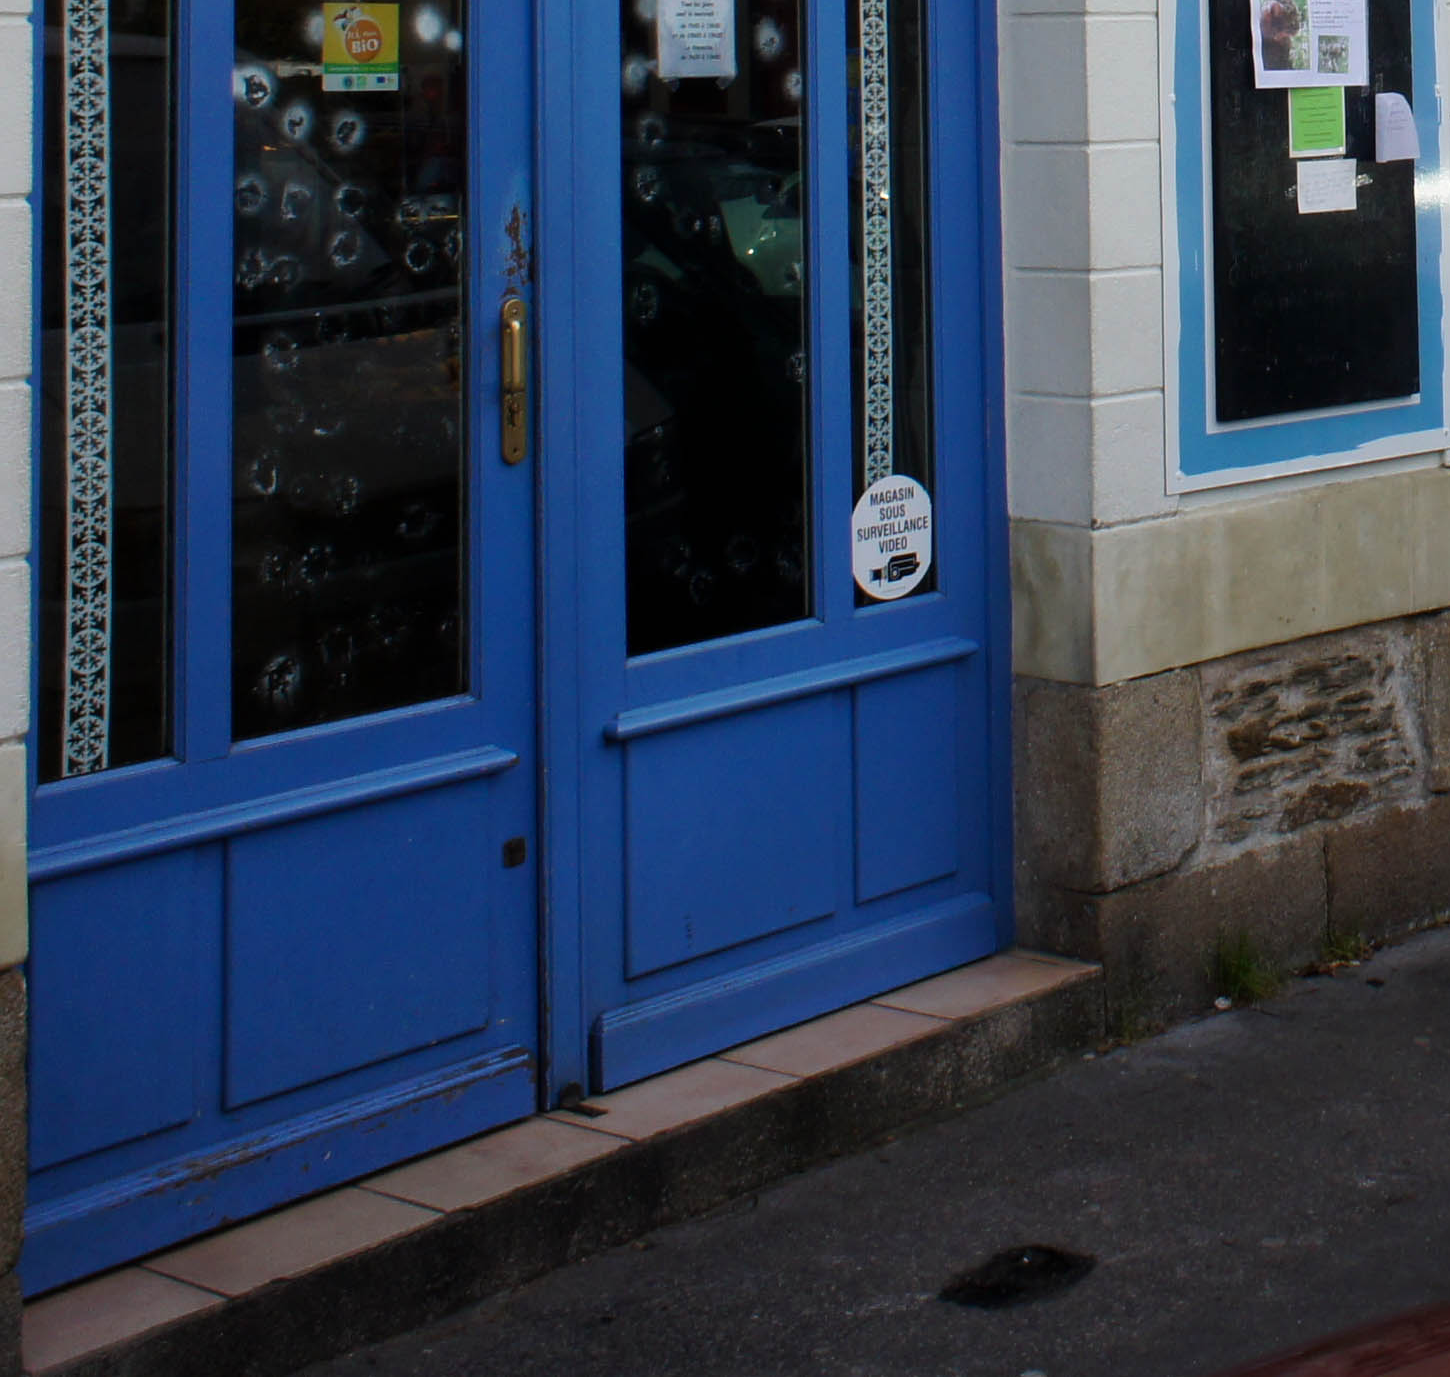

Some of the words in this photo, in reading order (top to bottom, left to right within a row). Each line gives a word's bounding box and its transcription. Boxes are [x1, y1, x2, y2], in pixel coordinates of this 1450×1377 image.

[870, 486, 914, 506] MAGASIN
[879, 504, 906, 521] SOUS
[856, 515, 929, 542] SURVEILLANCE
[878, 536, 908, 554] VIDEO
